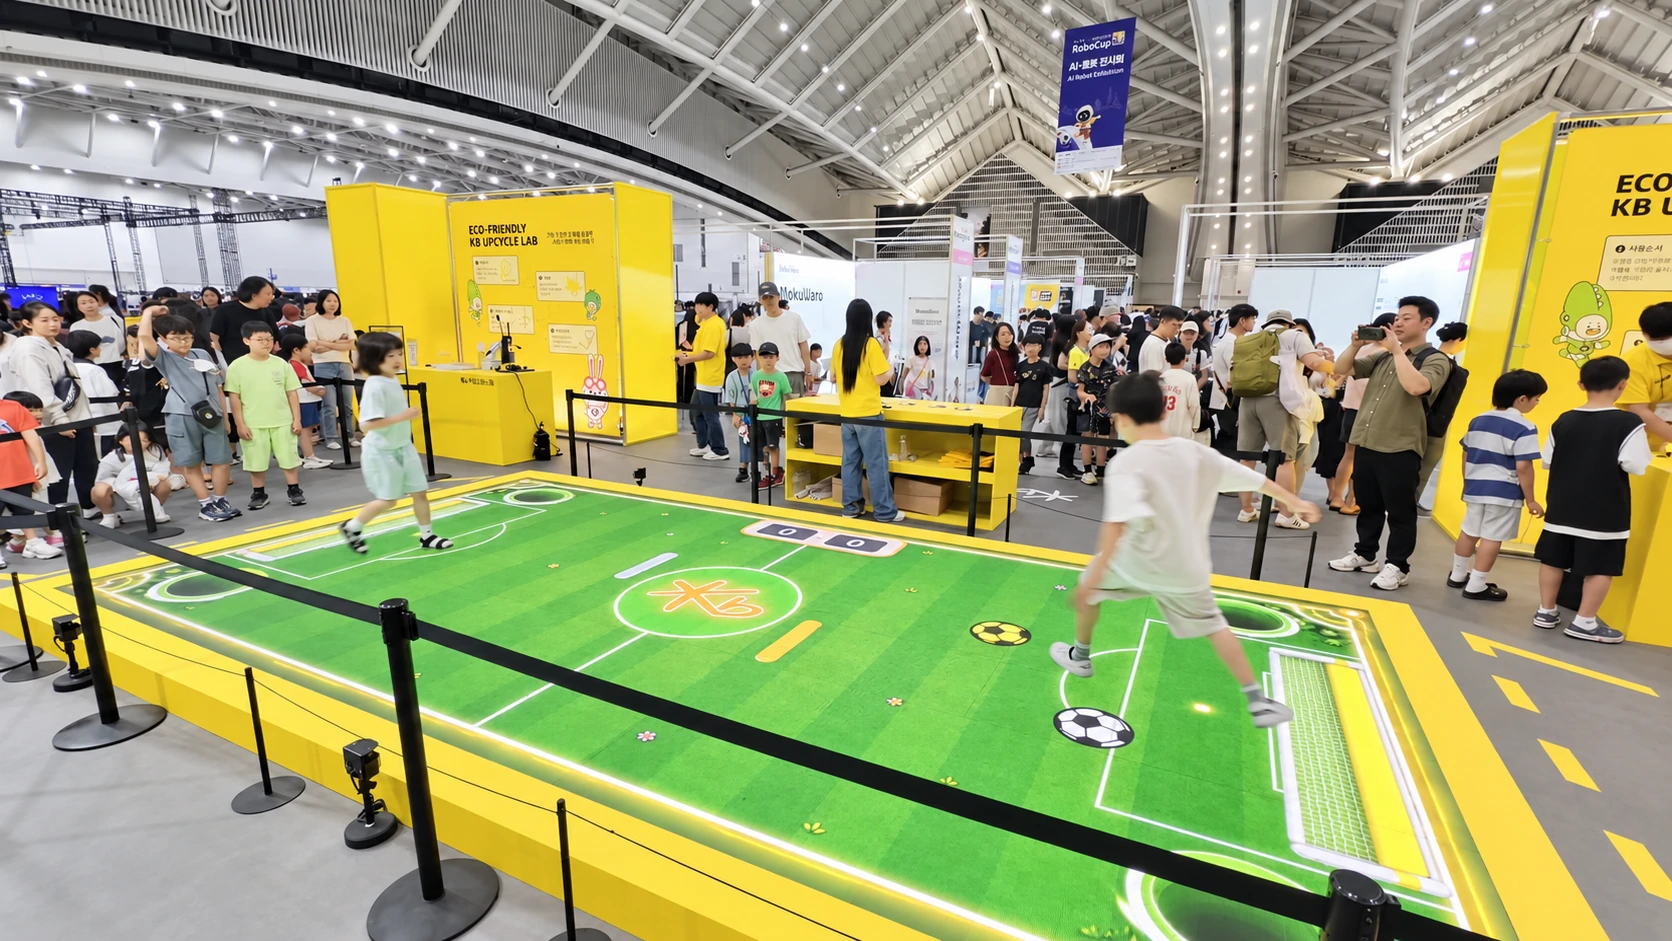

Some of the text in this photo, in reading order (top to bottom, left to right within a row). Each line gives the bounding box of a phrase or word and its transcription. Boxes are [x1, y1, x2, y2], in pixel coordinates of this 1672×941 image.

[1072, 40, 1111, 54] RoboCup
[1611, 198, 1652, 217] KB
[468, 223, 527, 235] ECO-FRIENDLY
[469, 235, 538, 248] KB UPCYCLE LAB
[779, 286, 824, 302] MokuWaro
[778, 528, 865, 548] 0 0
